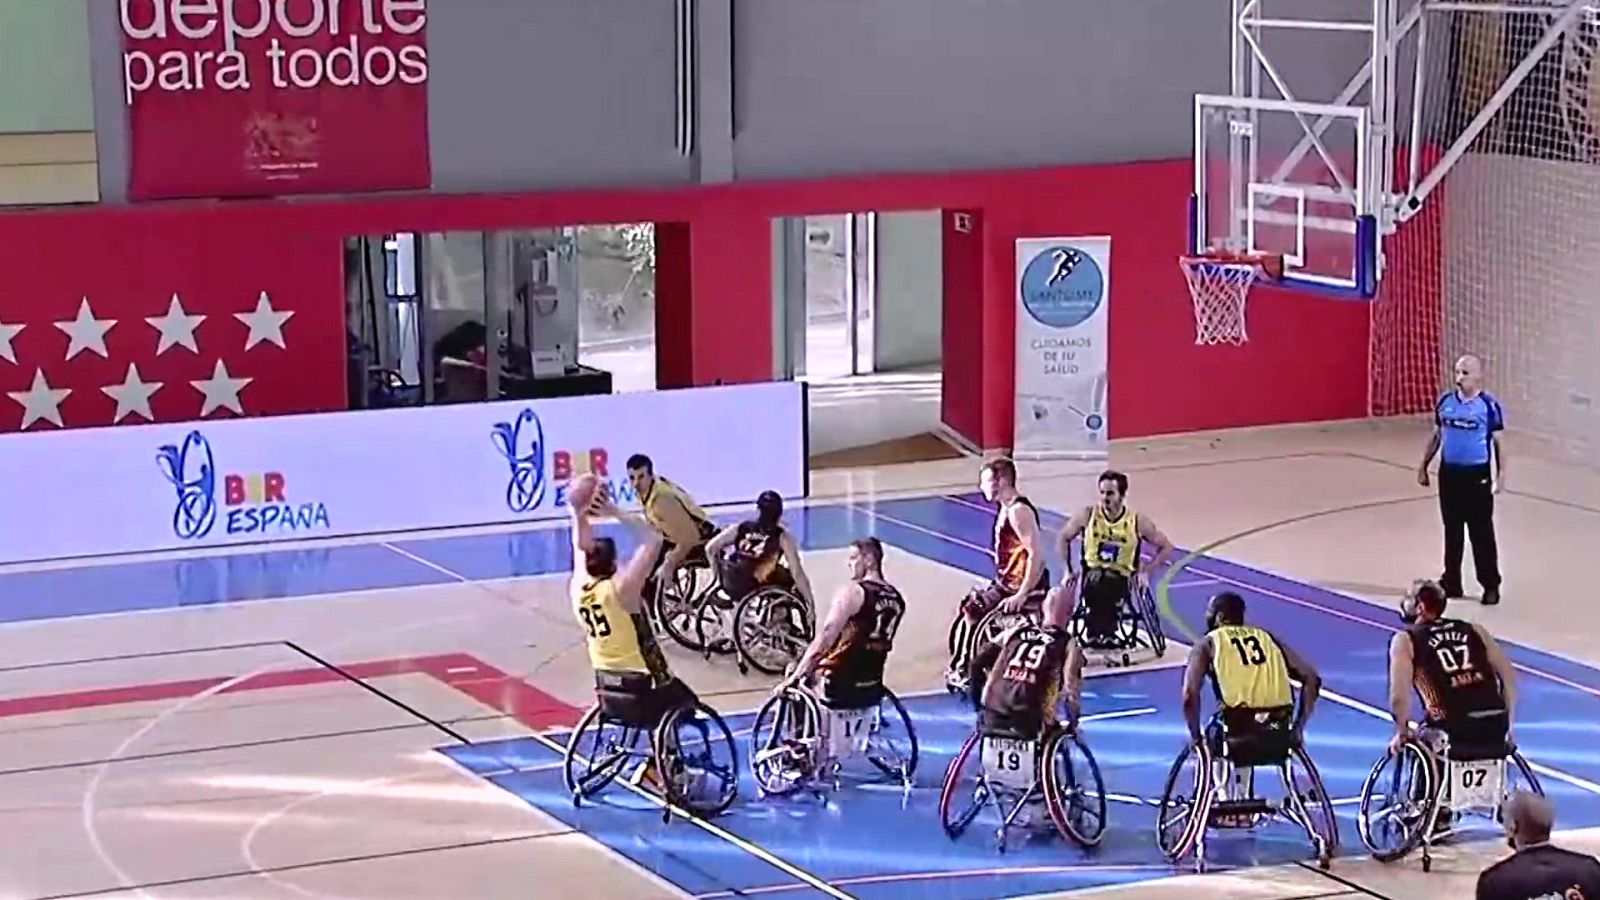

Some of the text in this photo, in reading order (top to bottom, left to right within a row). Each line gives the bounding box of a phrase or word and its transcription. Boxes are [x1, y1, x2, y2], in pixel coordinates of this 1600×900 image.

[119, 0, 427, 50] deporte
[124, 34, 428, 105] para todos
[226, 501, 331, 535] ESPAÑA
[1008, 641, 1047, 670] 19
[1230, 635, 1267, 666] 13
[1436, 644, 1475, 674] 07
[997, 750, 1021, 771] 19
[1462, 768, 1488, 789] 07
